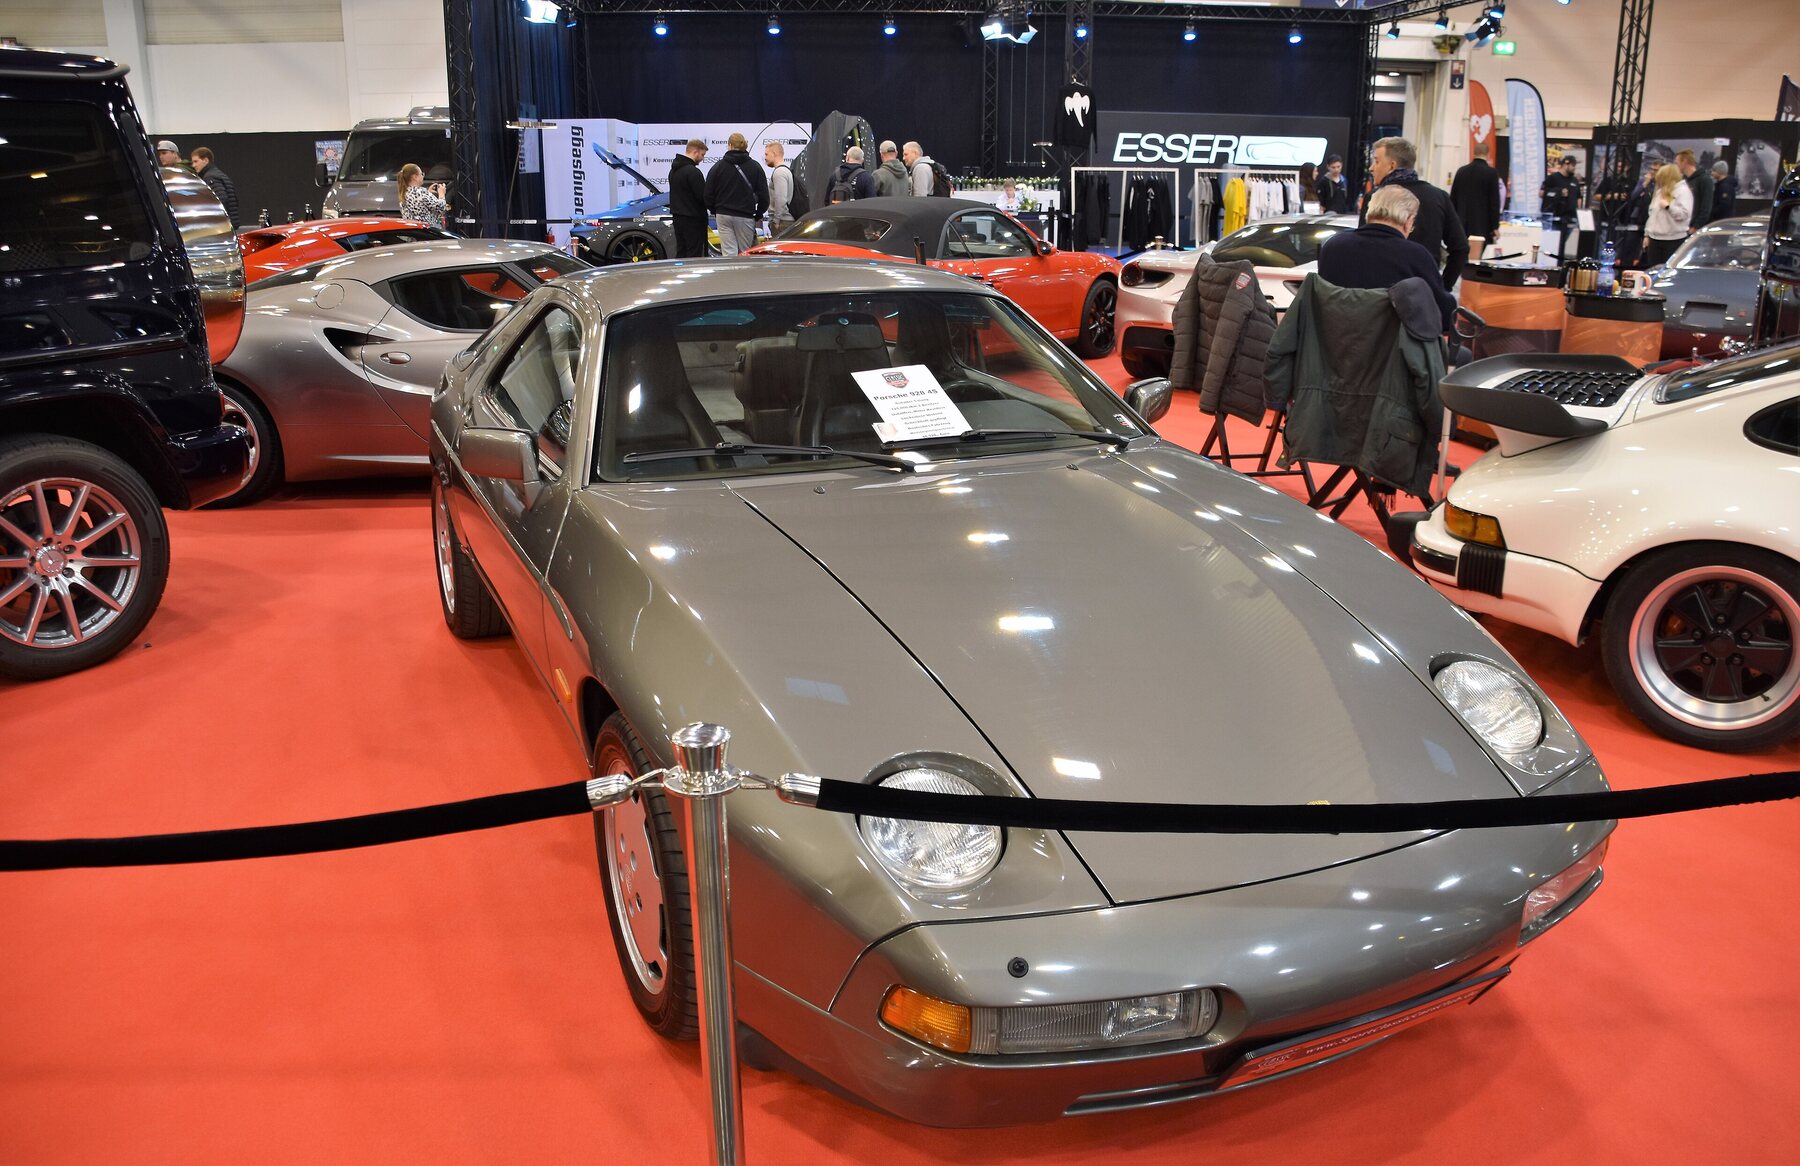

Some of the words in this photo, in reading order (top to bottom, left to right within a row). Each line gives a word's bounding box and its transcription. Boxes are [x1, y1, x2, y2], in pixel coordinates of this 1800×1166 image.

[1113, 132, 1238, 164] ESSER
[571, 126, 586, 215] oenigsegg
[873, 393, 908, 401] Porsche
